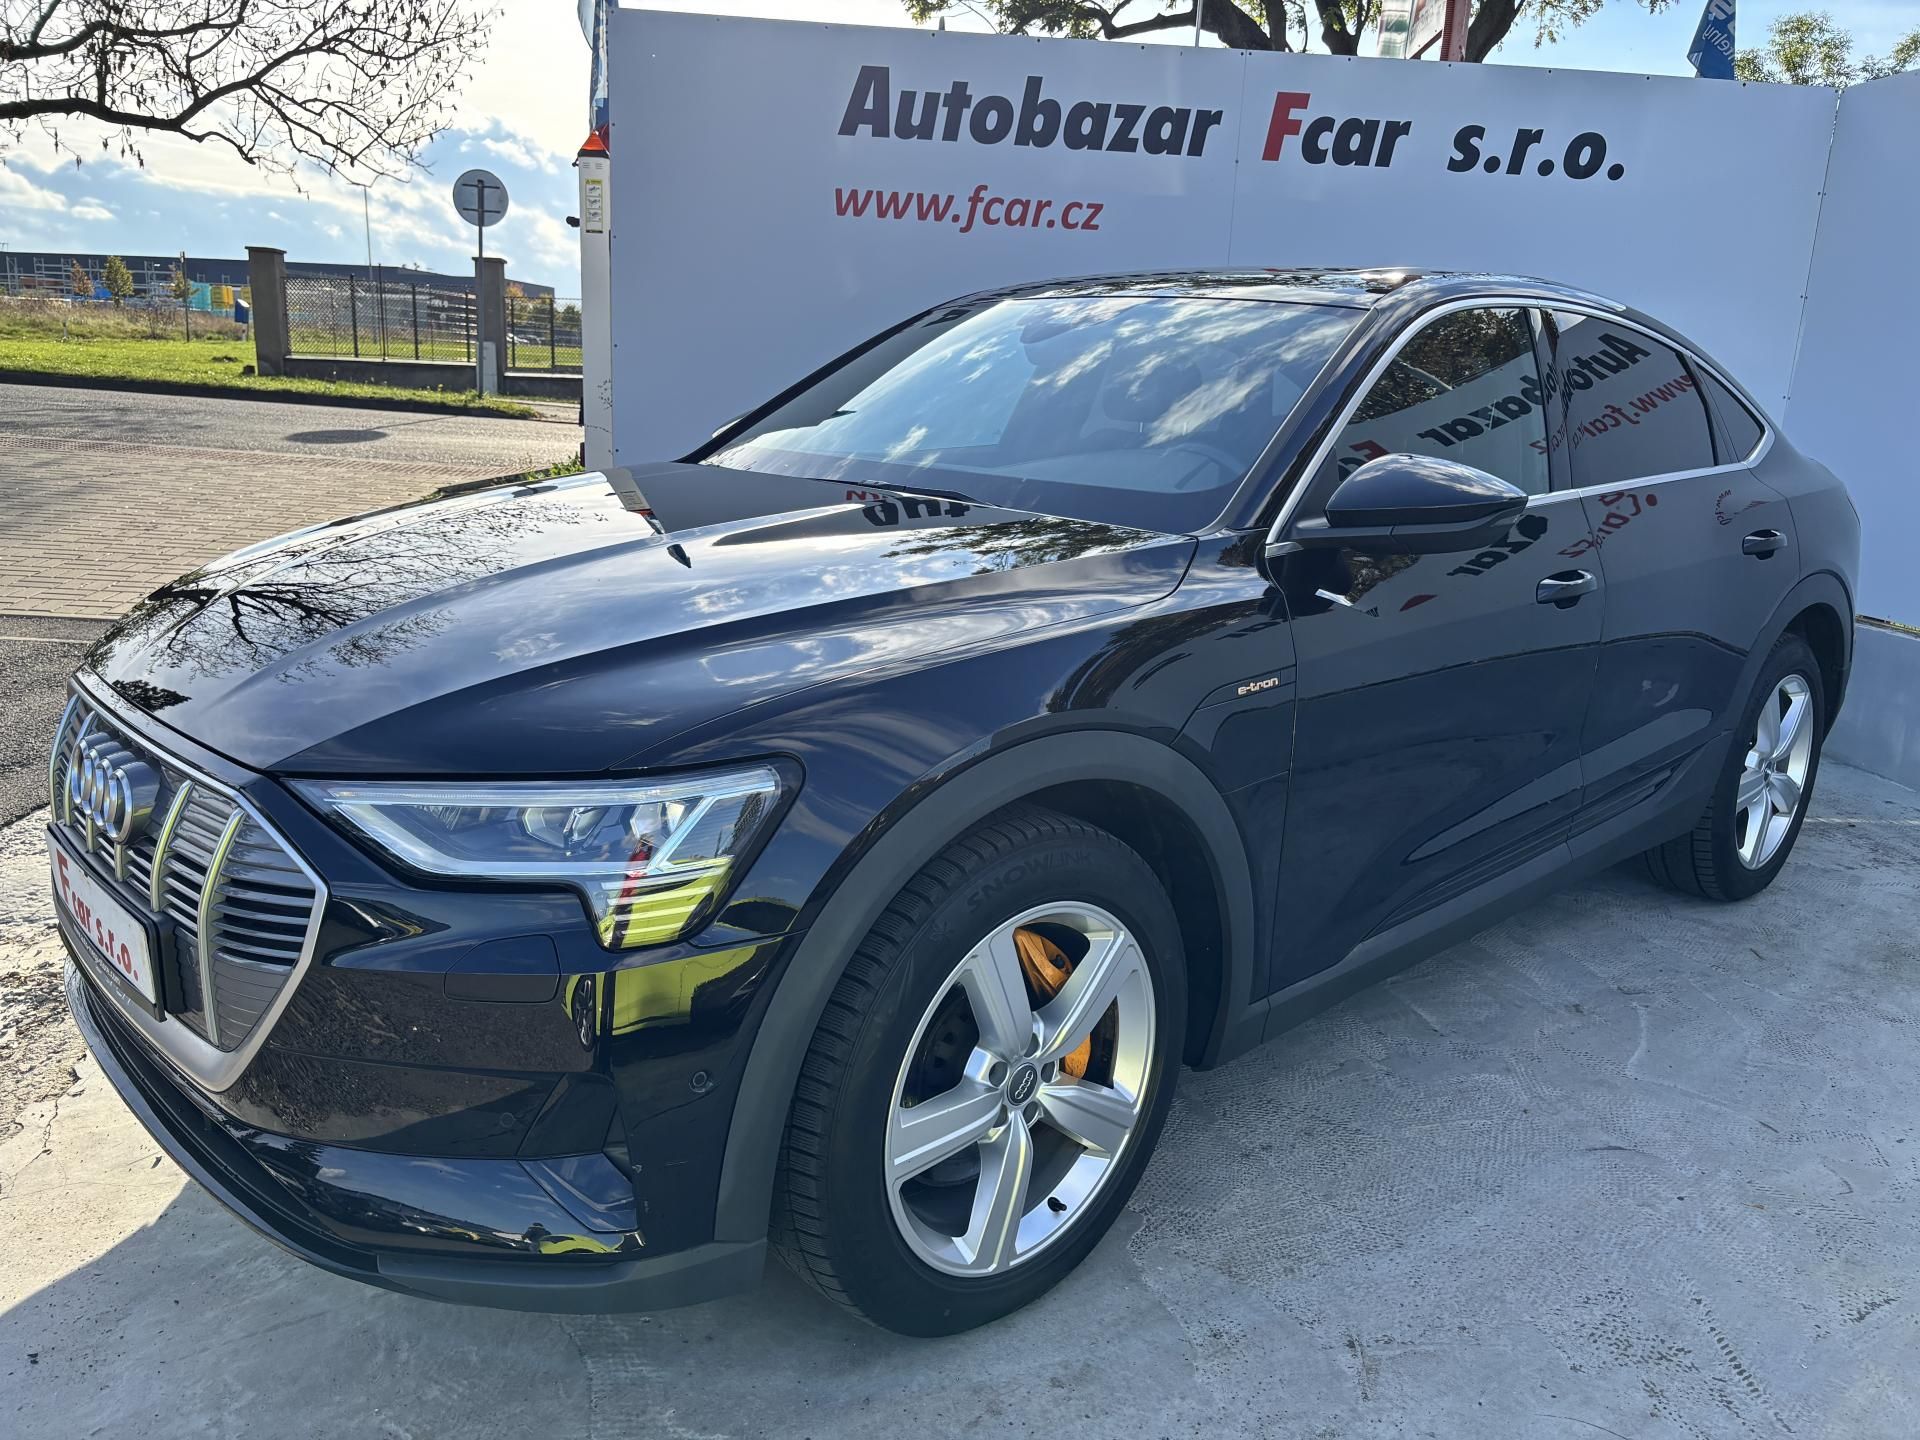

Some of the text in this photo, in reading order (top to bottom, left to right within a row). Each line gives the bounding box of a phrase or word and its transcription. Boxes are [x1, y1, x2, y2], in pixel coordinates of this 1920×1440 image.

[838, 66, 1625, 181] Autobazar Fcar s.r.o.
[834, 184, 1104, 233] www.fcar.cz
[1237, 677, 1279, 696] e-tron
[95, 917, 139, 982] s.r.o.
